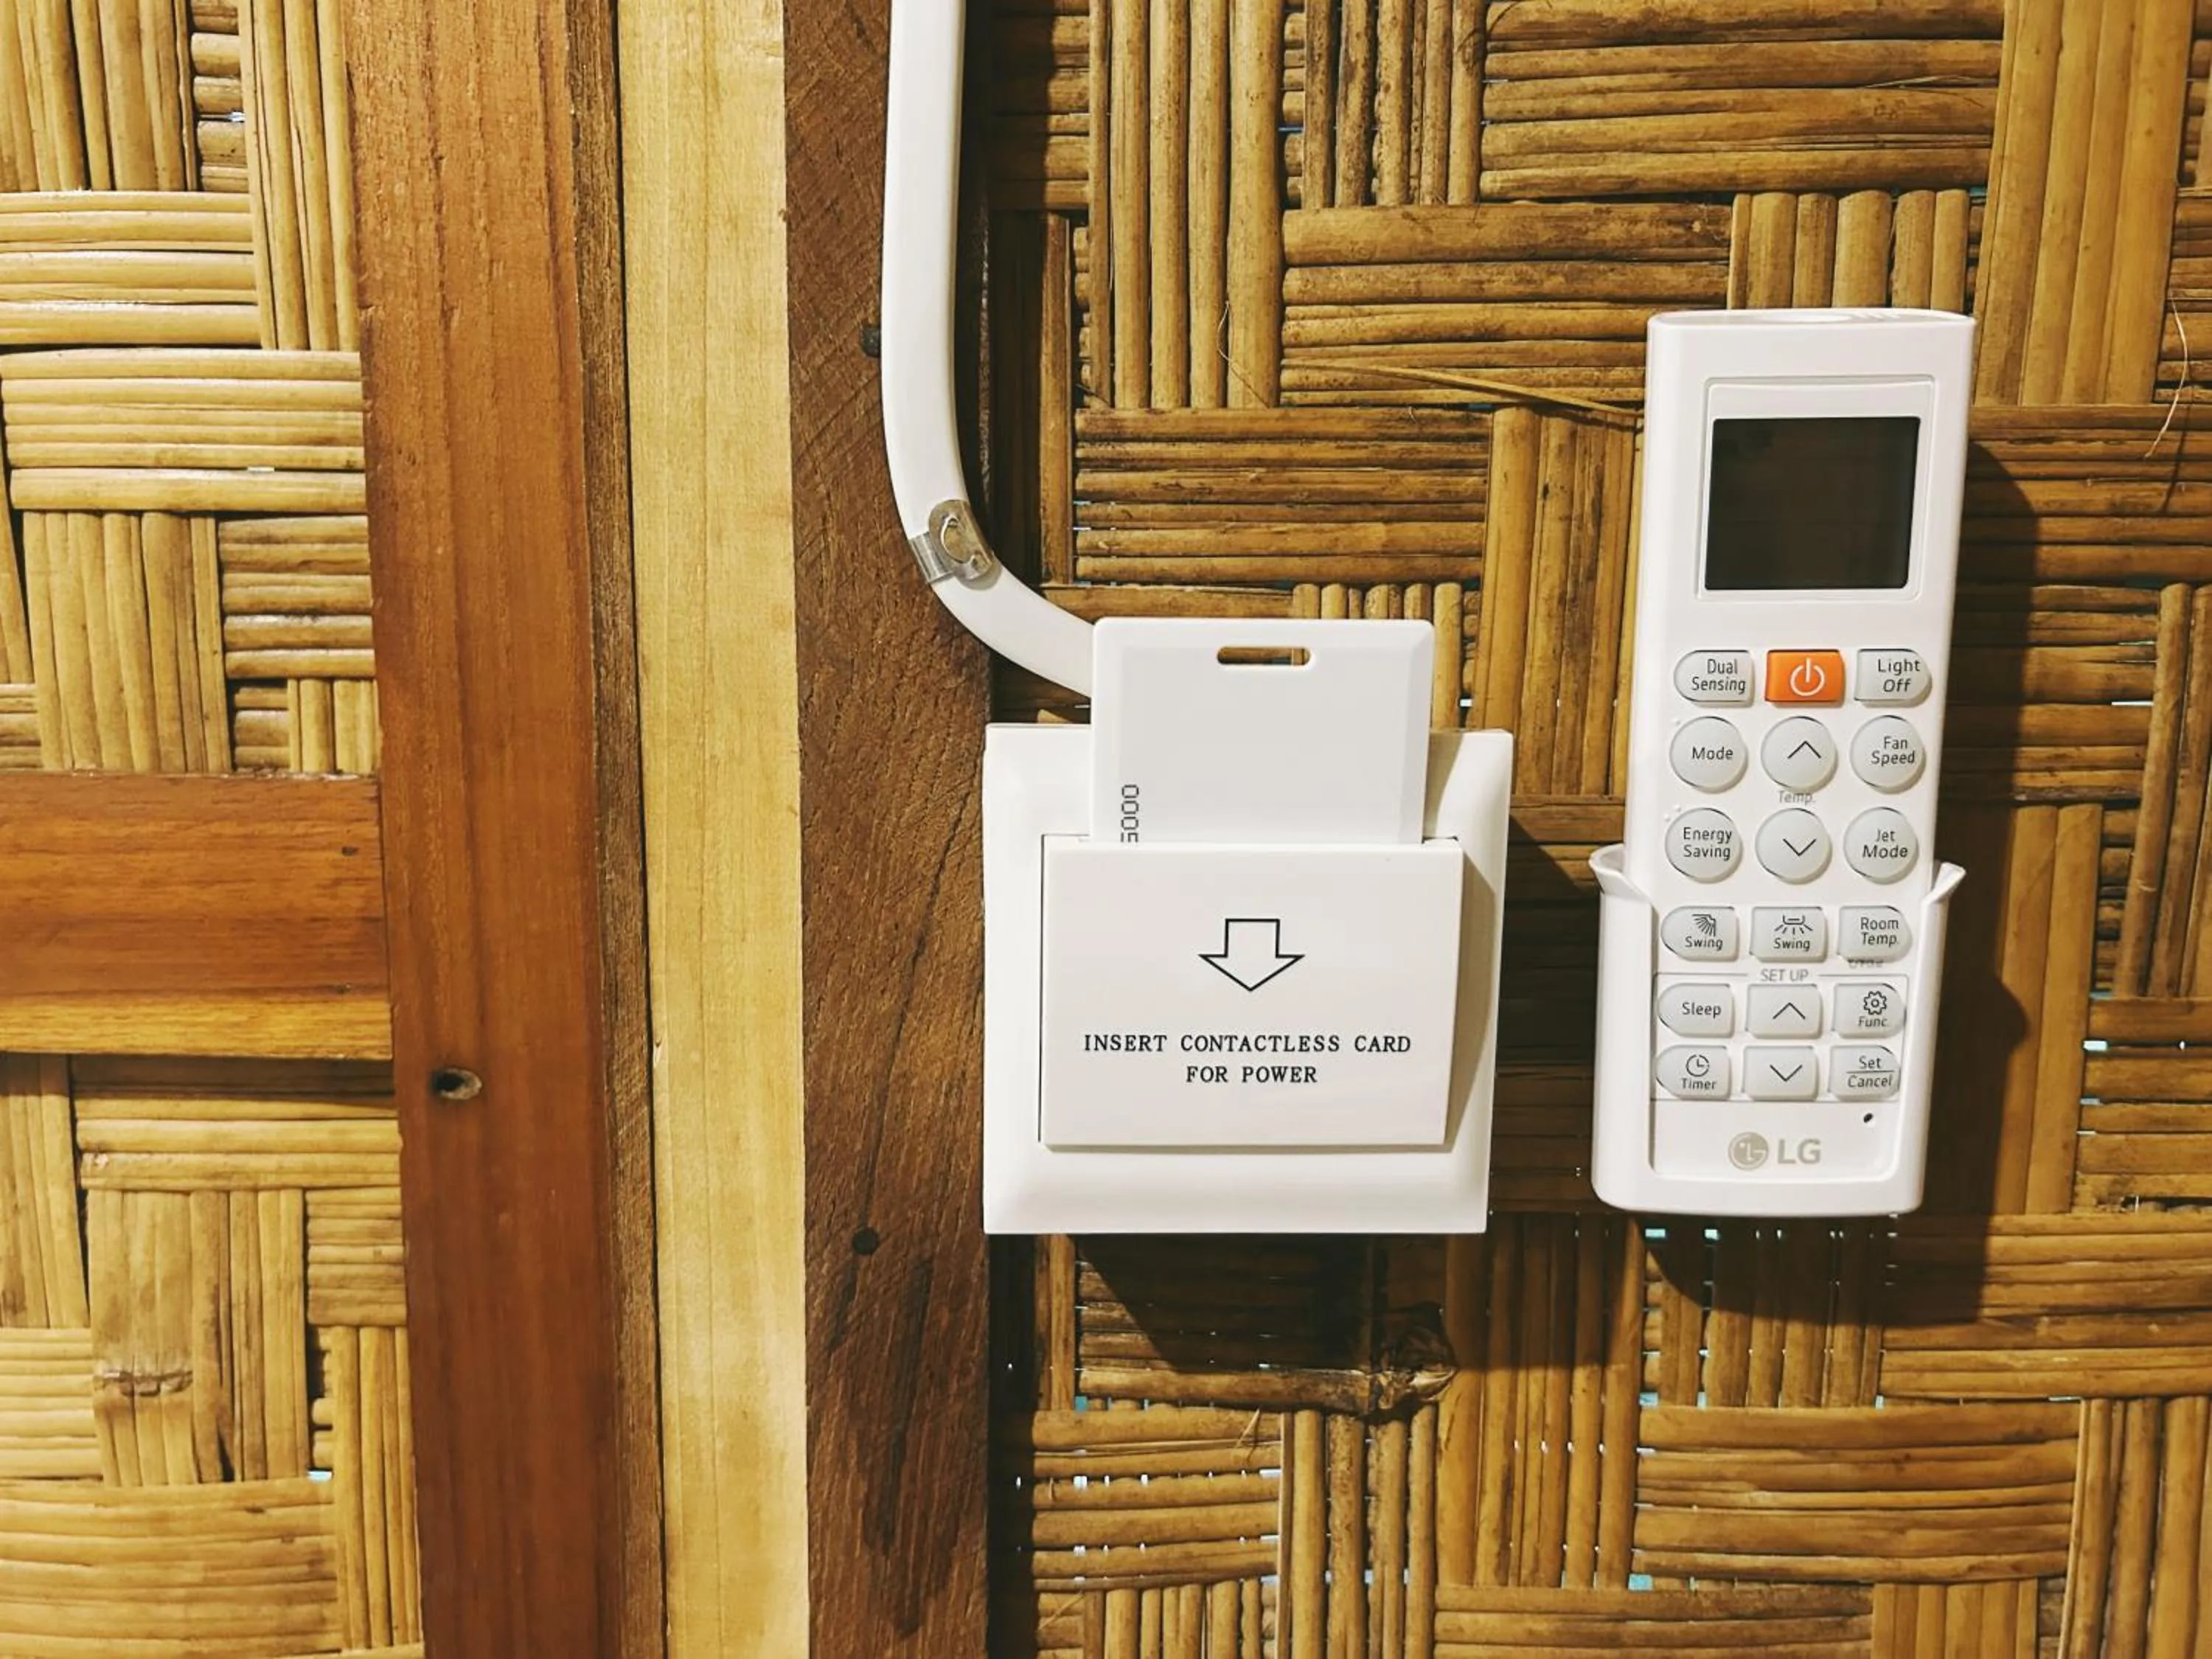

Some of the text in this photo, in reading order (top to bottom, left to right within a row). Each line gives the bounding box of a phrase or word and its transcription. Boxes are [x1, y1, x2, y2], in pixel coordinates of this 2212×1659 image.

[1707, 658, 1738, 675] Dual
[1877, 658, 1920, 676] Light
[1691, 676, 1746, 695] Sensing
[1883, 678, 1911, 692] Off
[1883, 737, 1908, 749] Fan
[1691, 746, 1733, 760] Mode
[1871, 751, 1916, 767] Speed
[1683, 827, 1732, 846] Energy
[1876, 830, 1895, 843] Jet
[1683, 846, 1731, 861] Saving
[1863, 844, 1908, 858] Mode
[1860, 917, 1899, 930] Room
[1684, 936, 1723, 950] Swing
[1773, 937, 1811, 951] Swing
[1760, 968, 1809, 982] SET UP
[1681, 1001, 1722, 1018] Sleep
[1084, 1034, 1412, 1053] INSERT CONTACTLESS CARD
[1859, 1056, 1882, 1070] Set
[1186, 1066, 1318, 1083] FOR POWER
[1681, 1077, 1717, 1091] Timer
[1848, 1075, 1893, 1089] Cancel
[1778, 1138, 1822, 1165] LG
